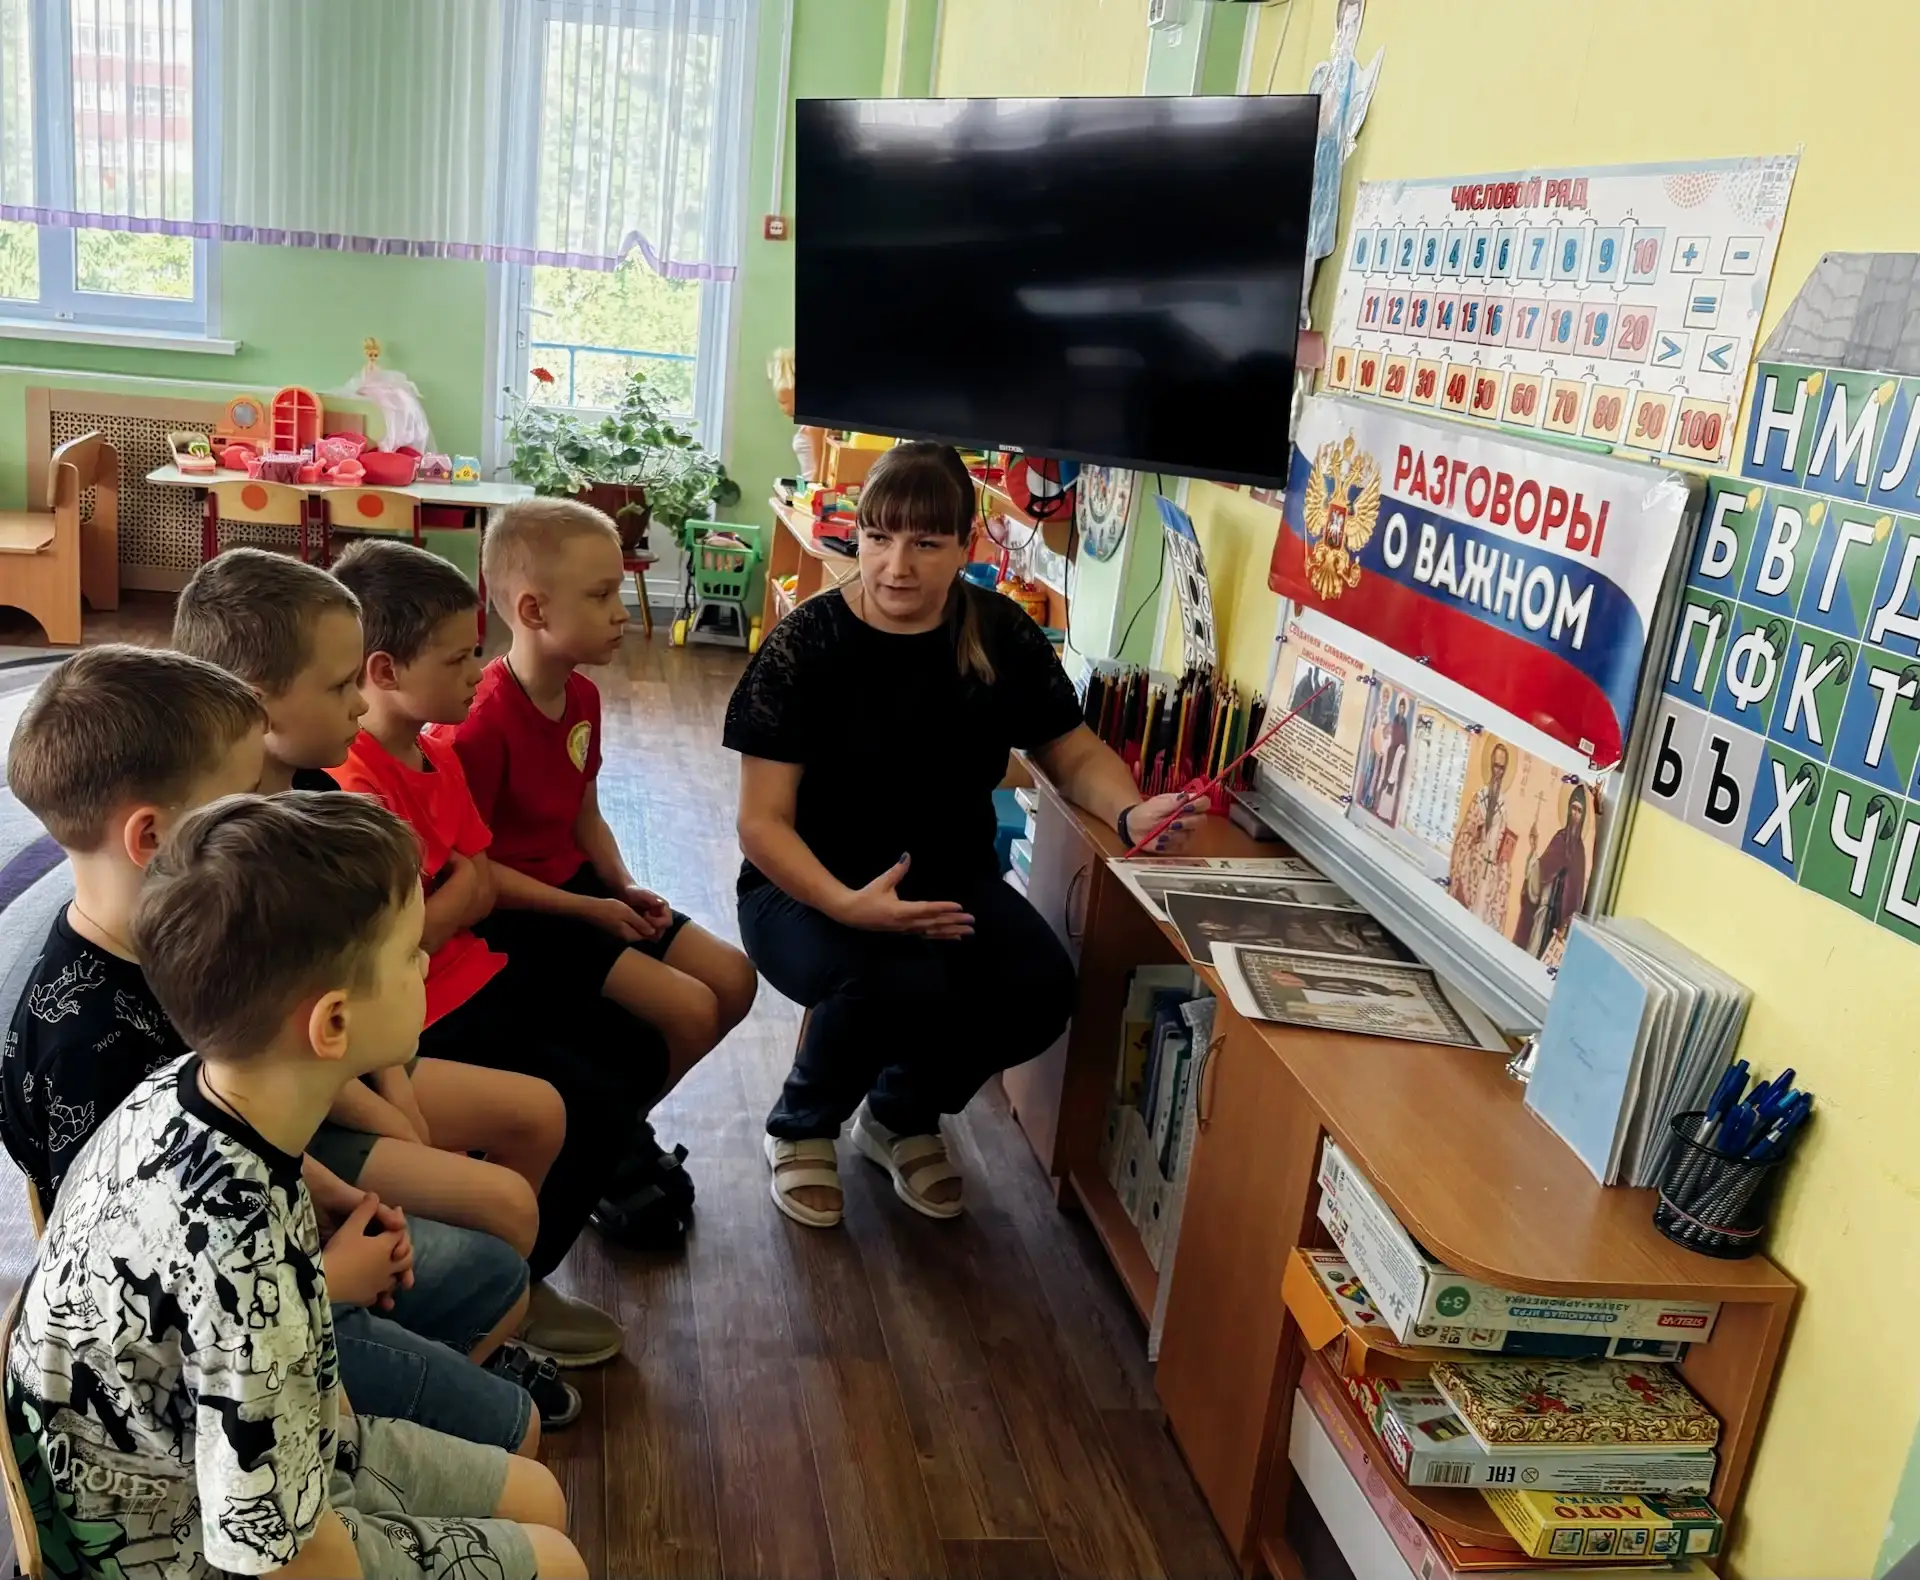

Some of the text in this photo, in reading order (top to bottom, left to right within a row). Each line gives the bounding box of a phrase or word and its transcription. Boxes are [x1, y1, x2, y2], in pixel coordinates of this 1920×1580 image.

[1451, 176, 1588, 211] ЧИСЛОВОЙ РЯД
[1356, 237, 1367, 264] 0
[1379, 238, 1387, 265] 1
[1401, 238, 1413, 266] 2
[1424, 237, 1437, 267] 3
[1448, 238, 1461, 268] 4
[1473, 238, 1486, 269] 5
[1498, 238, 1510, 270] 6
[1530, 238, 1545, 270] 7
[1562, 238, 1577, 272] 8
[1599, 238, 1615, 273] 9
[1633, 238, 1658, 274] 10
[1364, 296, 1380, 323] 11
[1388, 296, 1404, 324] 12
[1411, 299, 1428, 327] 13
[1437, 300, 1454, 330] 14
[1462, 302, 1478, 332] 15
[1486, 304, 1503, 336] 16
[1516, 306, 1540, 339] 17
[1551, 310, 1572, 343] 18
[1584, 311, 1609, 346] 19
[1618, 315, 1649, 350] 20
[1336, 356, 1722, 450] 0 10 20 30 40 50 60 70 80 90 100
[1752, 375, 1809, 471] Н
[1808, 383, 1880, 486] М
[1393, 444, 1610, 558] РАЗГОВОРЫ
[1383, 512, 1595, 650] О ВАЖНОМ
[1699, 491, 1747, 579] Б
[1756, 505, 1803, 596] В
[1817, 520, 1876, 613] Г
[1670, 602, 1918, 769] П Ф К Т
[1651, 714, 1684, 800] Ь
[1704, 734, 1742, 827] Ъ
[1752, 759, 1811, 864] Х
[1829, 790, 1883, 898] Ч
[1440, 1296, 1466, 1311] 3+
[1511, 1307, 1614, 1322] ОБУЧАЮЩАЯ ИГРА
[1552, 1505, 1643, 1520] ЛОТО
[1635, 1532, 1646, 1544] Б
[1667, 1531, 1678, 1550] К
